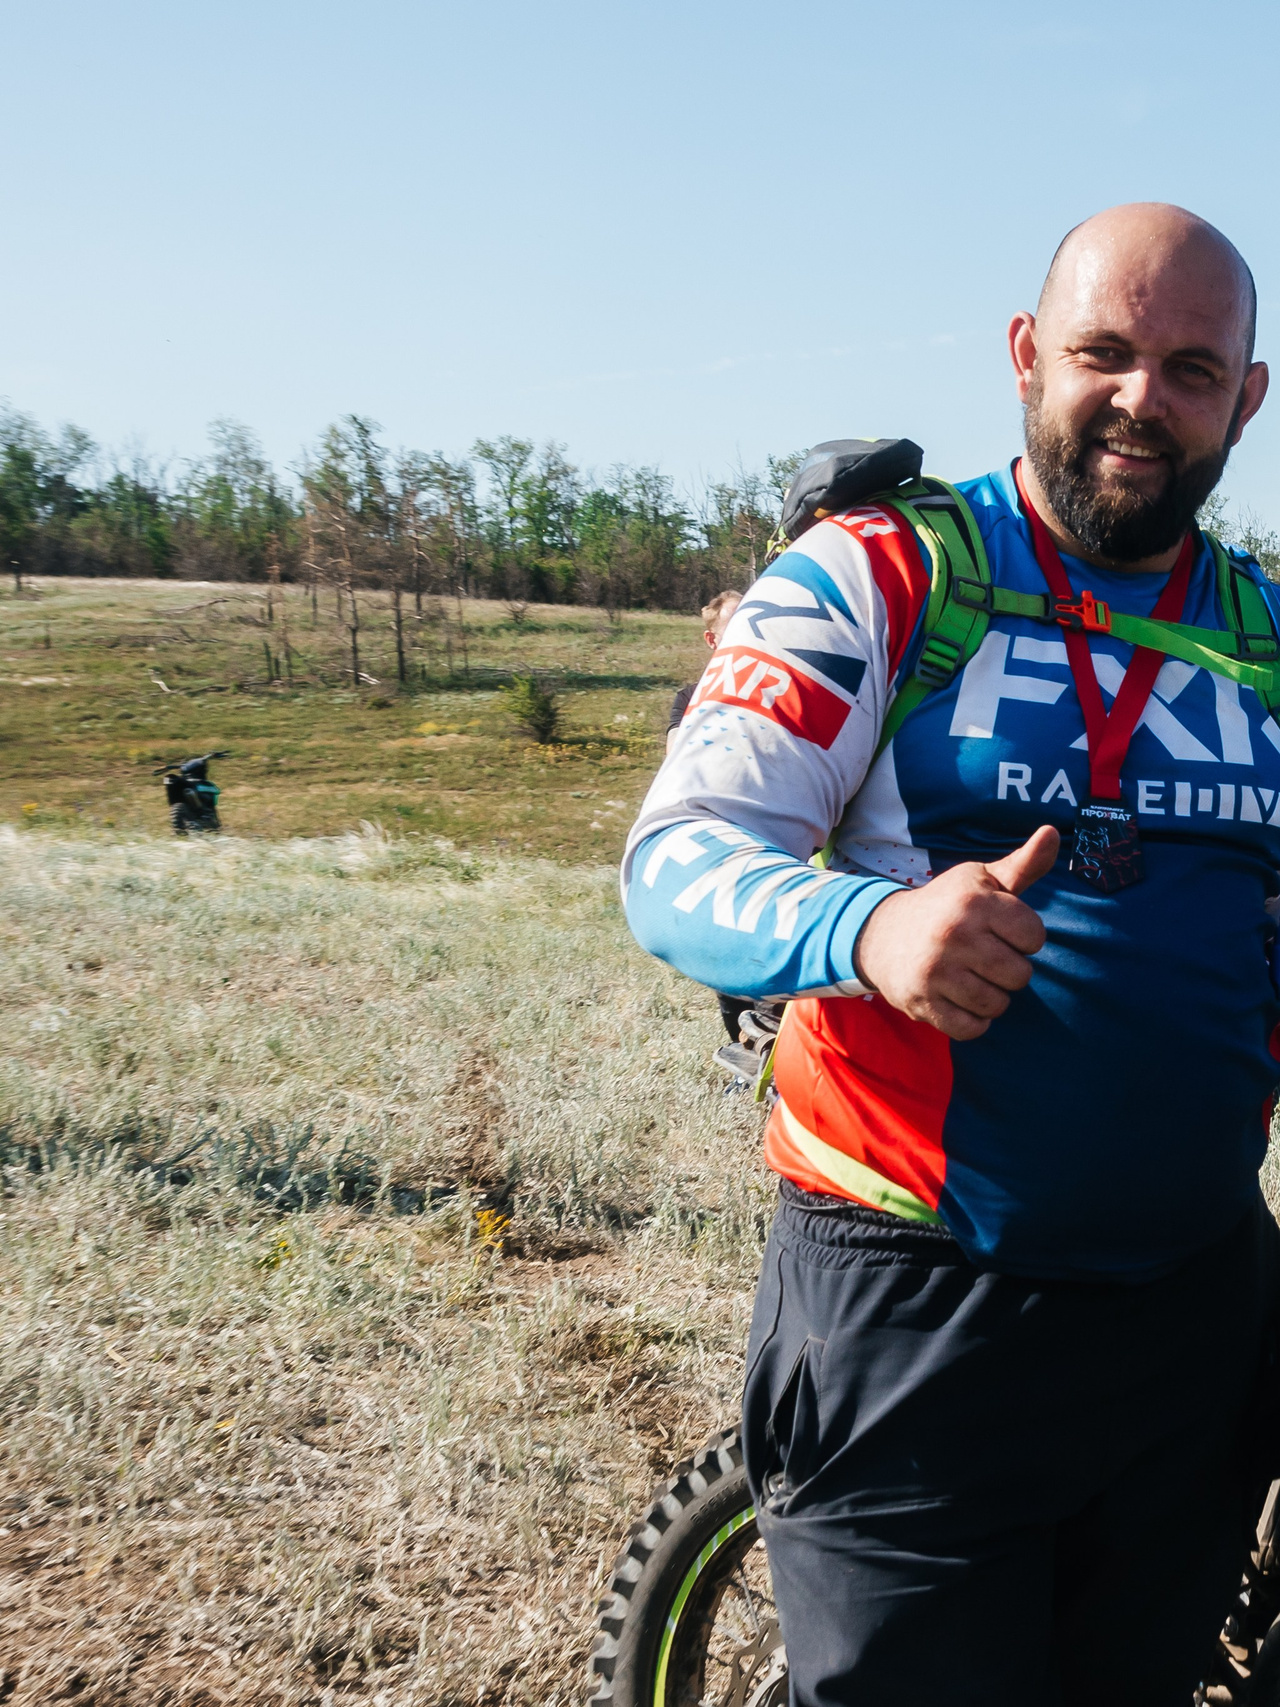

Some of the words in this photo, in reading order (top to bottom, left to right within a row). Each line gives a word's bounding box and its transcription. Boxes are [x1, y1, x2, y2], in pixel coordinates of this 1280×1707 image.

[688, 653, 793, 710] FXR
[997, 761, 1166, 816] RAE
[642, 819, 846, 941] FXR
